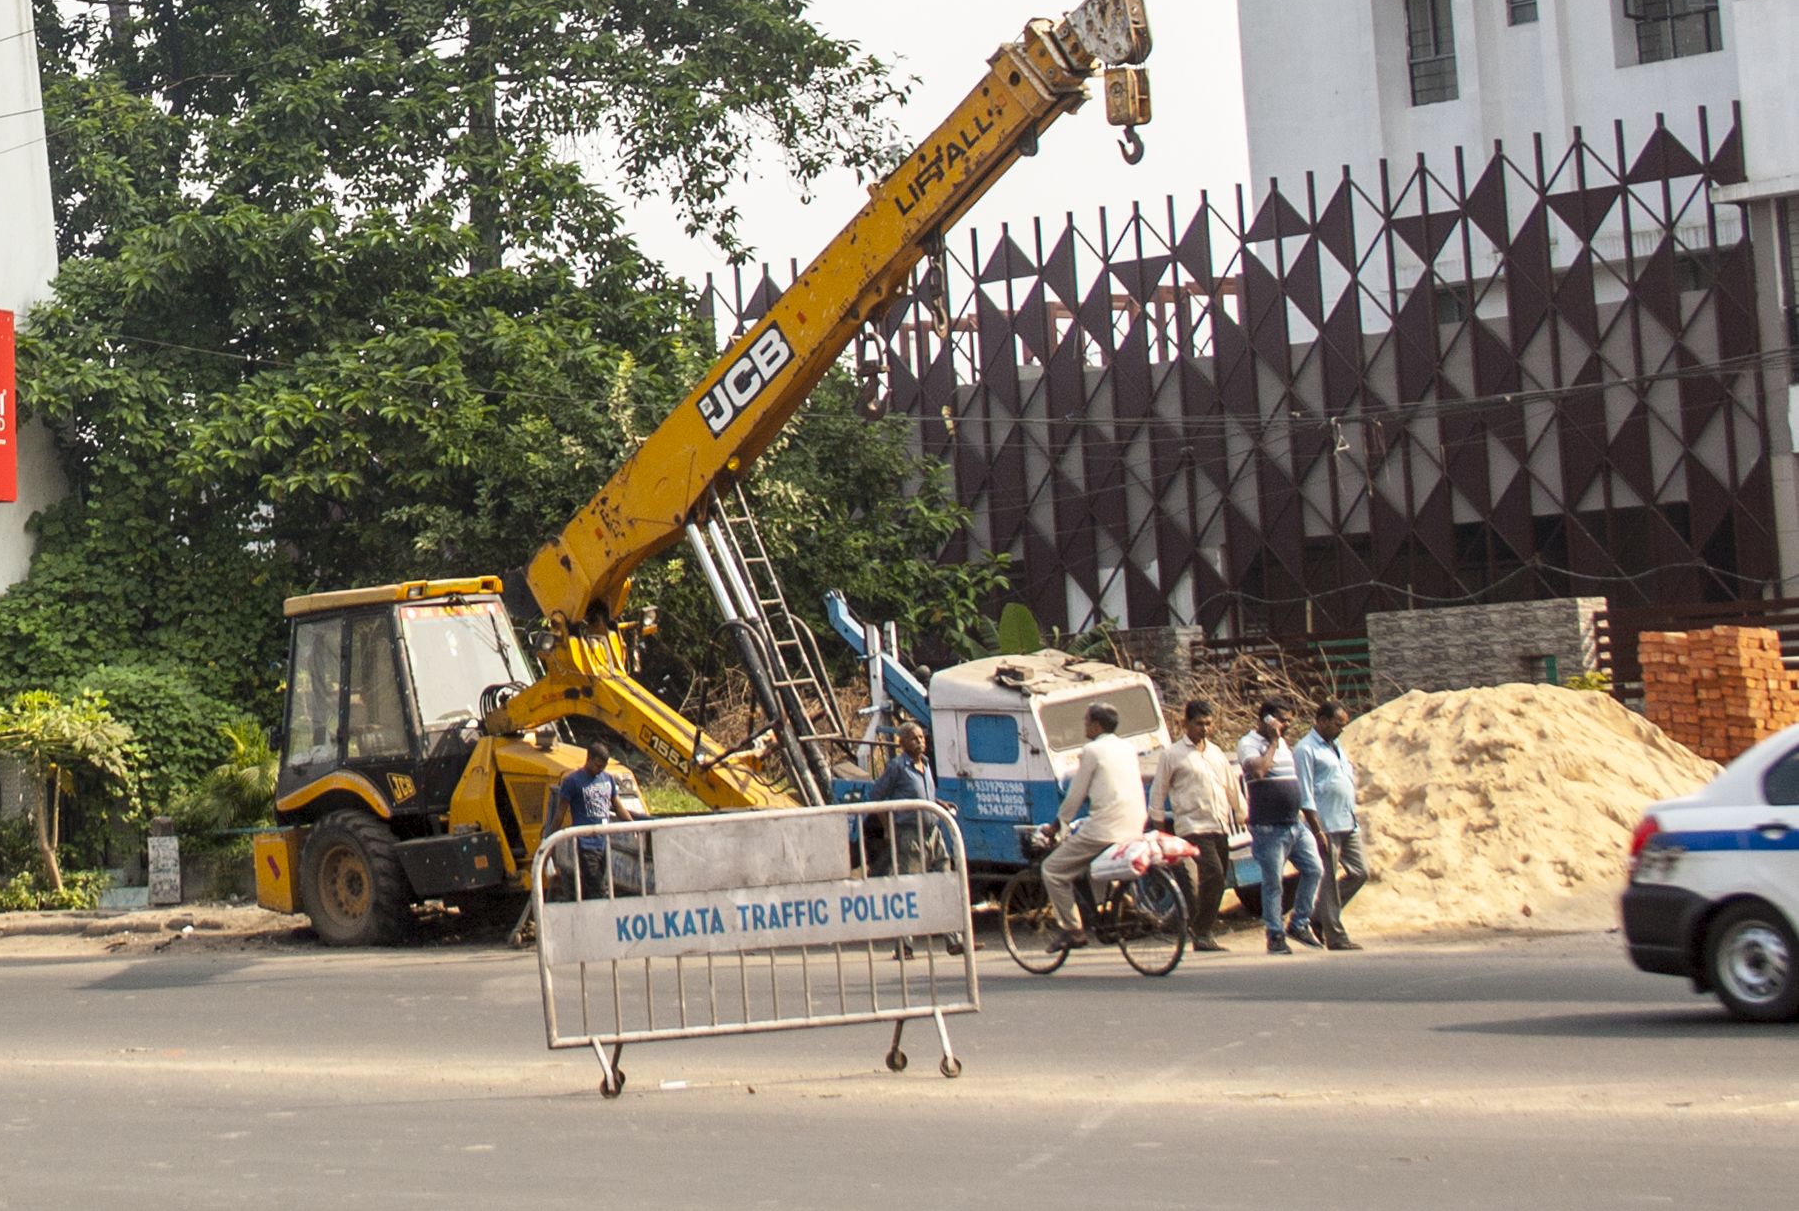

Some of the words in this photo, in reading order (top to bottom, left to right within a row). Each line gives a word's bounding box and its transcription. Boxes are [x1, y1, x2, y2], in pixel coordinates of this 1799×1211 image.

[708, 328, 790, 432] JCB
[651, 735, 689, 774] 1554
[616, 907, 724, 942] KOLKATA
[736, 899, 830, 932] TRAFFIC
[840, 891, 919, 923] POLICE
